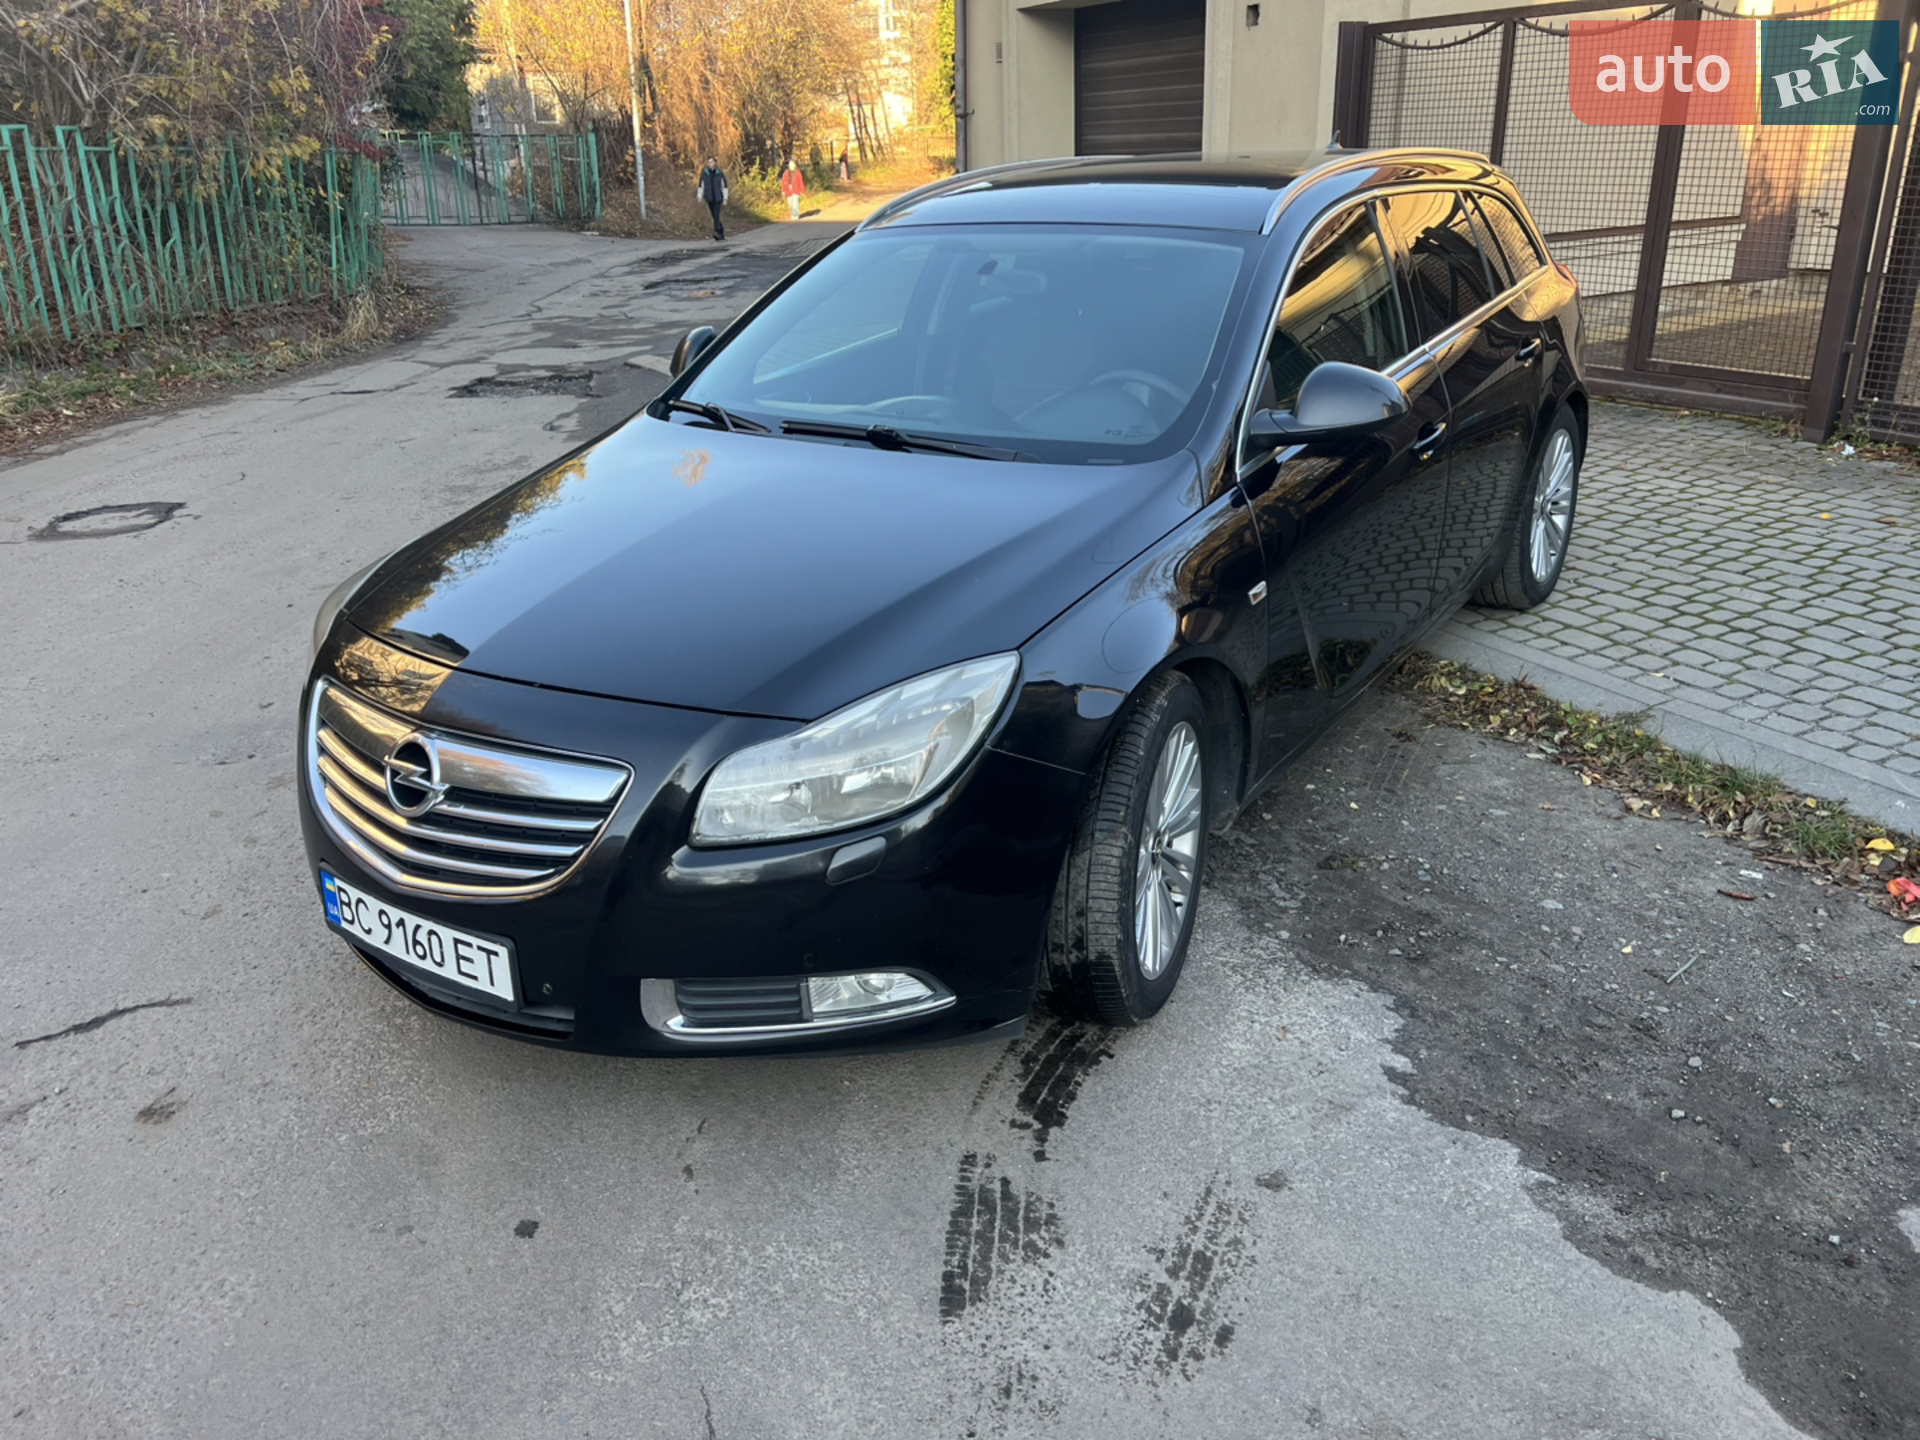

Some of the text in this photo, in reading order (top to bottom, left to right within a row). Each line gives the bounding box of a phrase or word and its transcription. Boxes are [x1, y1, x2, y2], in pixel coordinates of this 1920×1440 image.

[336, 885, 500, 987] BC 9160 ET
